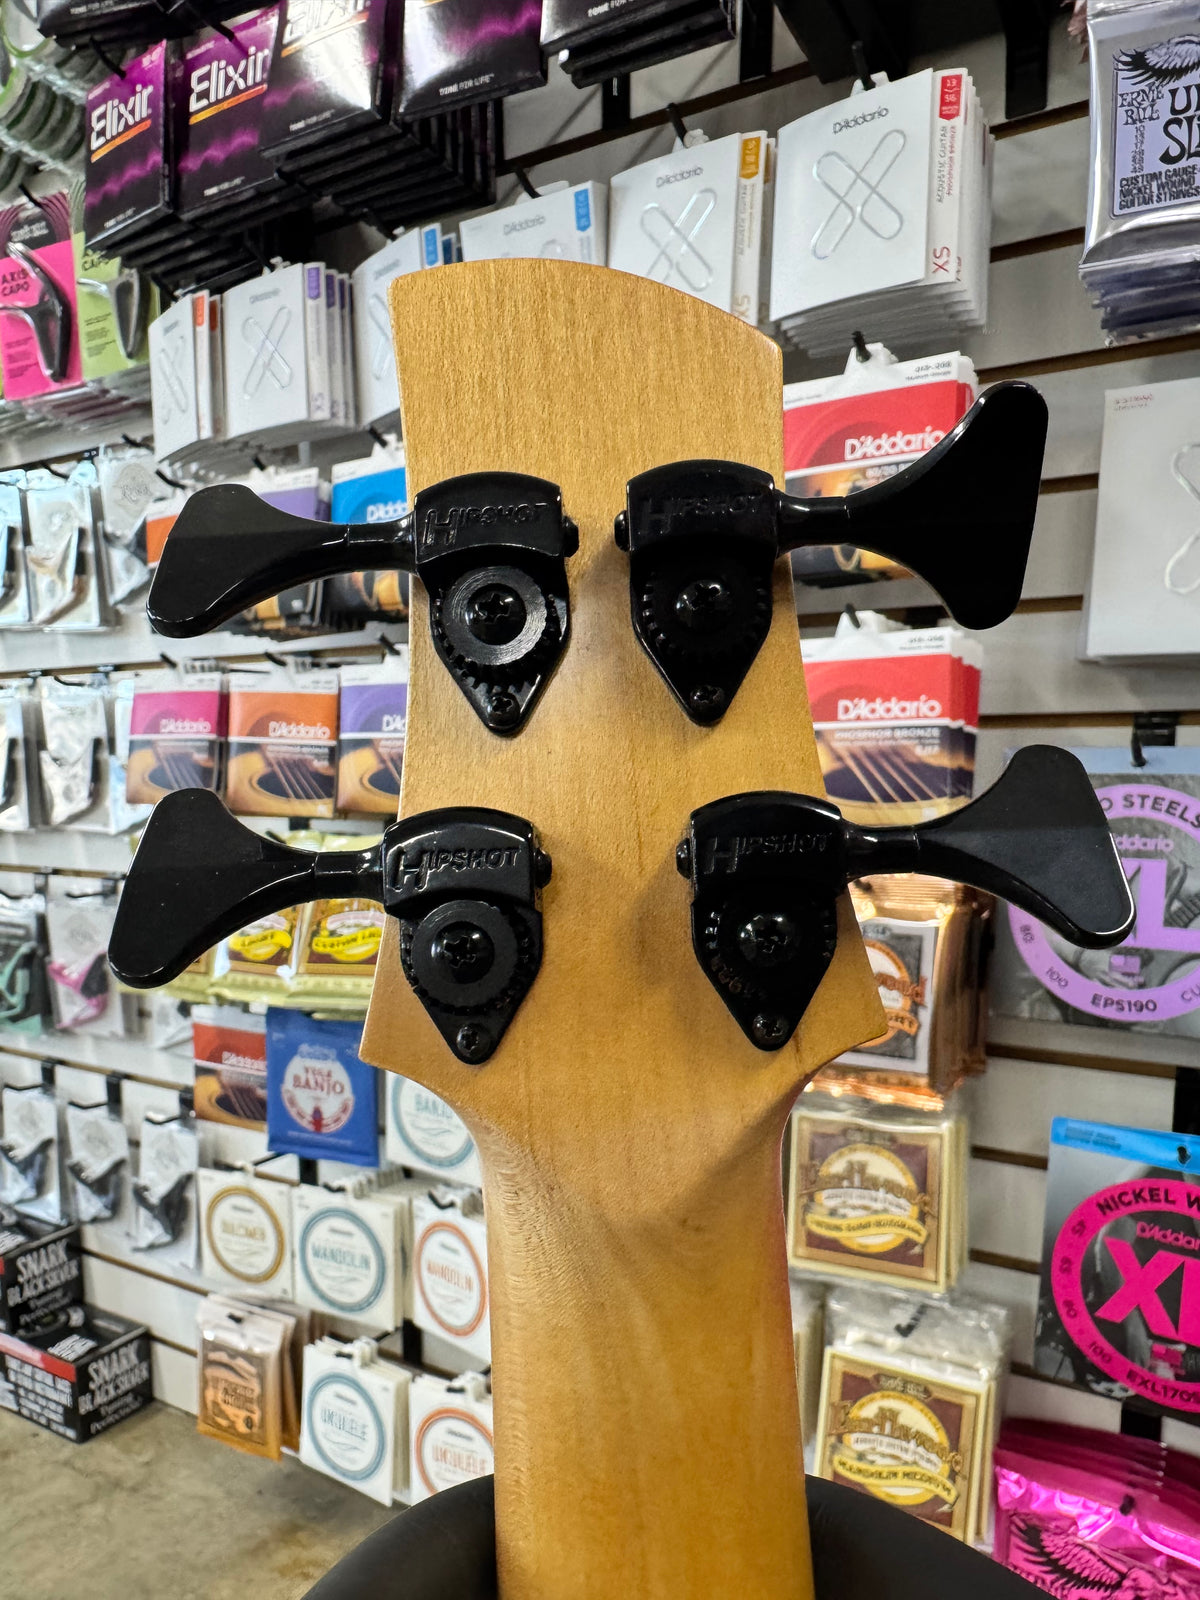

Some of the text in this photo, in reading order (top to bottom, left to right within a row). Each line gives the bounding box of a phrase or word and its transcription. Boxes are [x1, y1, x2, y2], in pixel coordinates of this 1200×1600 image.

[189, 46, 270, 112] Elixir
[90, 84, 154, 150] Elixir
[932, 246, 950, 274] XS
[421, 502, 549, 545] HIPSHOT
[838, 695, 942, 720] D'Addario
[387, 846, 523, 894] HIPSHOT
[704, 833, 834, 876] HIPSHOT
[1096, 1187, 1177, 1217] NICKEL
